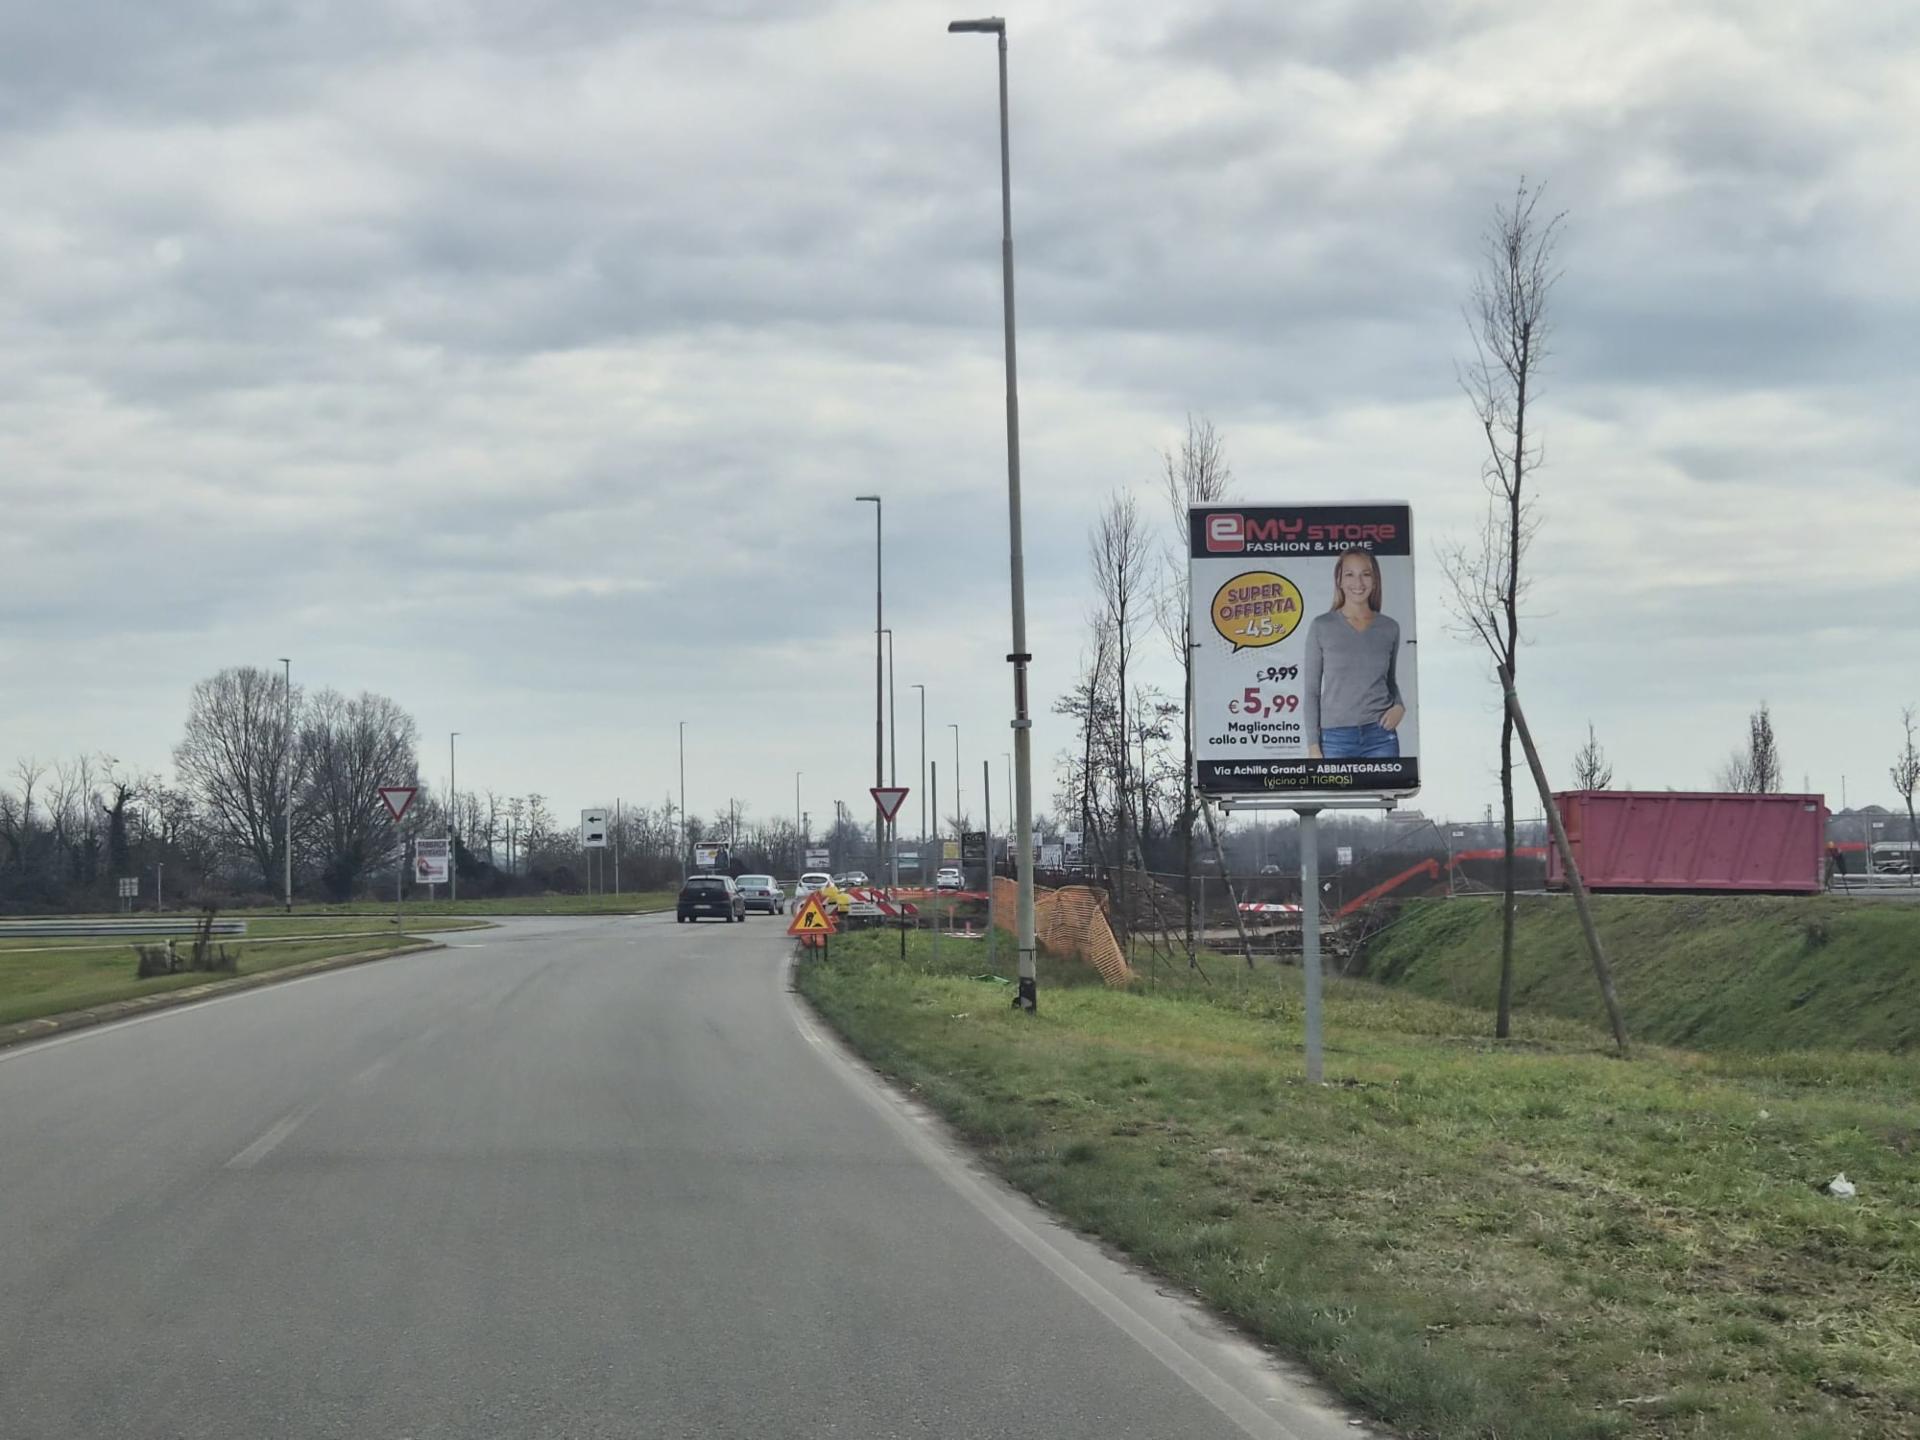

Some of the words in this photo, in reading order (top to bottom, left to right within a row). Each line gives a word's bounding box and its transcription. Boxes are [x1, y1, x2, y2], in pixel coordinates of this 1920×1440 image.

[1246, 542, 1310, 551] FASHION
[1314, 542, 1324, 551] &
[1328, 541, 1373, 551] HOME
[1228, 583, 1281, 602] SUPER
[1220, 597, 1296, 621] OFFERTA
[1228, 721, 1300, 734] Maglioncino
[1208, 734, 1237, 745] collo
[1240, 736, 1248, 745] a
[1250, 734, 1259, 744] V
[1262, 734, 1301, 744] Donna
[1214, 766, 1231, 776] Via
[1233, 765, 1268, 775] Achille
[1270, 764, 1306, 775] Grandi
[1316, 763, 1402, 774] ABBIATEGRASSO
[1263, 776, 1296, 786] (vicino
[1299, 776, 1309, 785] al
[1311, 774, 1353, 785] TIGROS)
